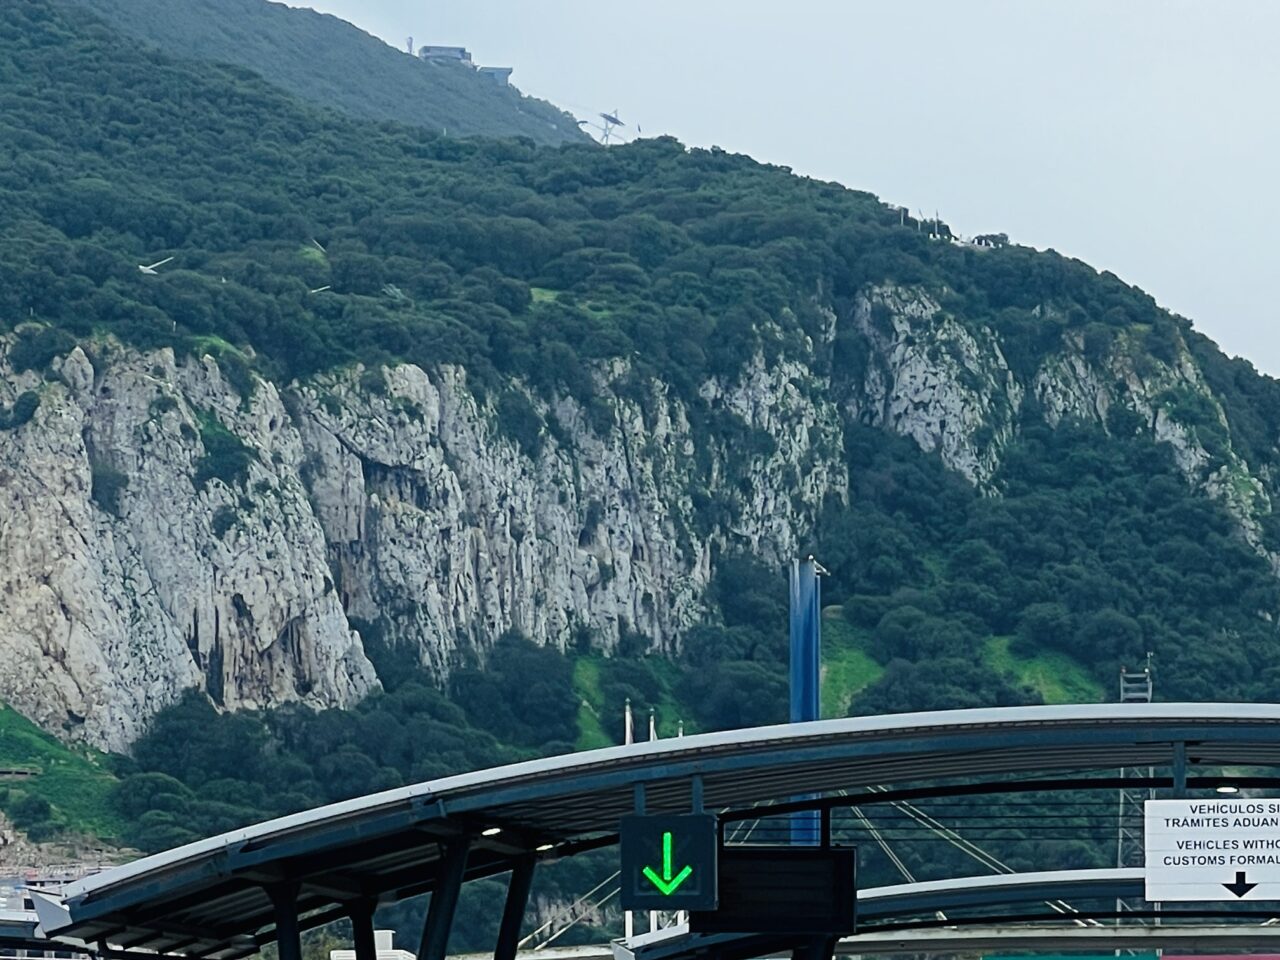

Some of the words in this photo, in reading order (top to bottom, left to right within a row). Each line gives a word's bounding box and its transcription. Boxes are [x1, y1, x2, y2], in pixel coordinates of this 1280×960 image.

[1190, 803, 1264, 814] VEHÍCULOS
[1164, 816, 1229, 828] TRÁMITES
[1176, 840, 1239, 850] VEHICLES
[1163, 856, 1226, 866] CUSTOMS
